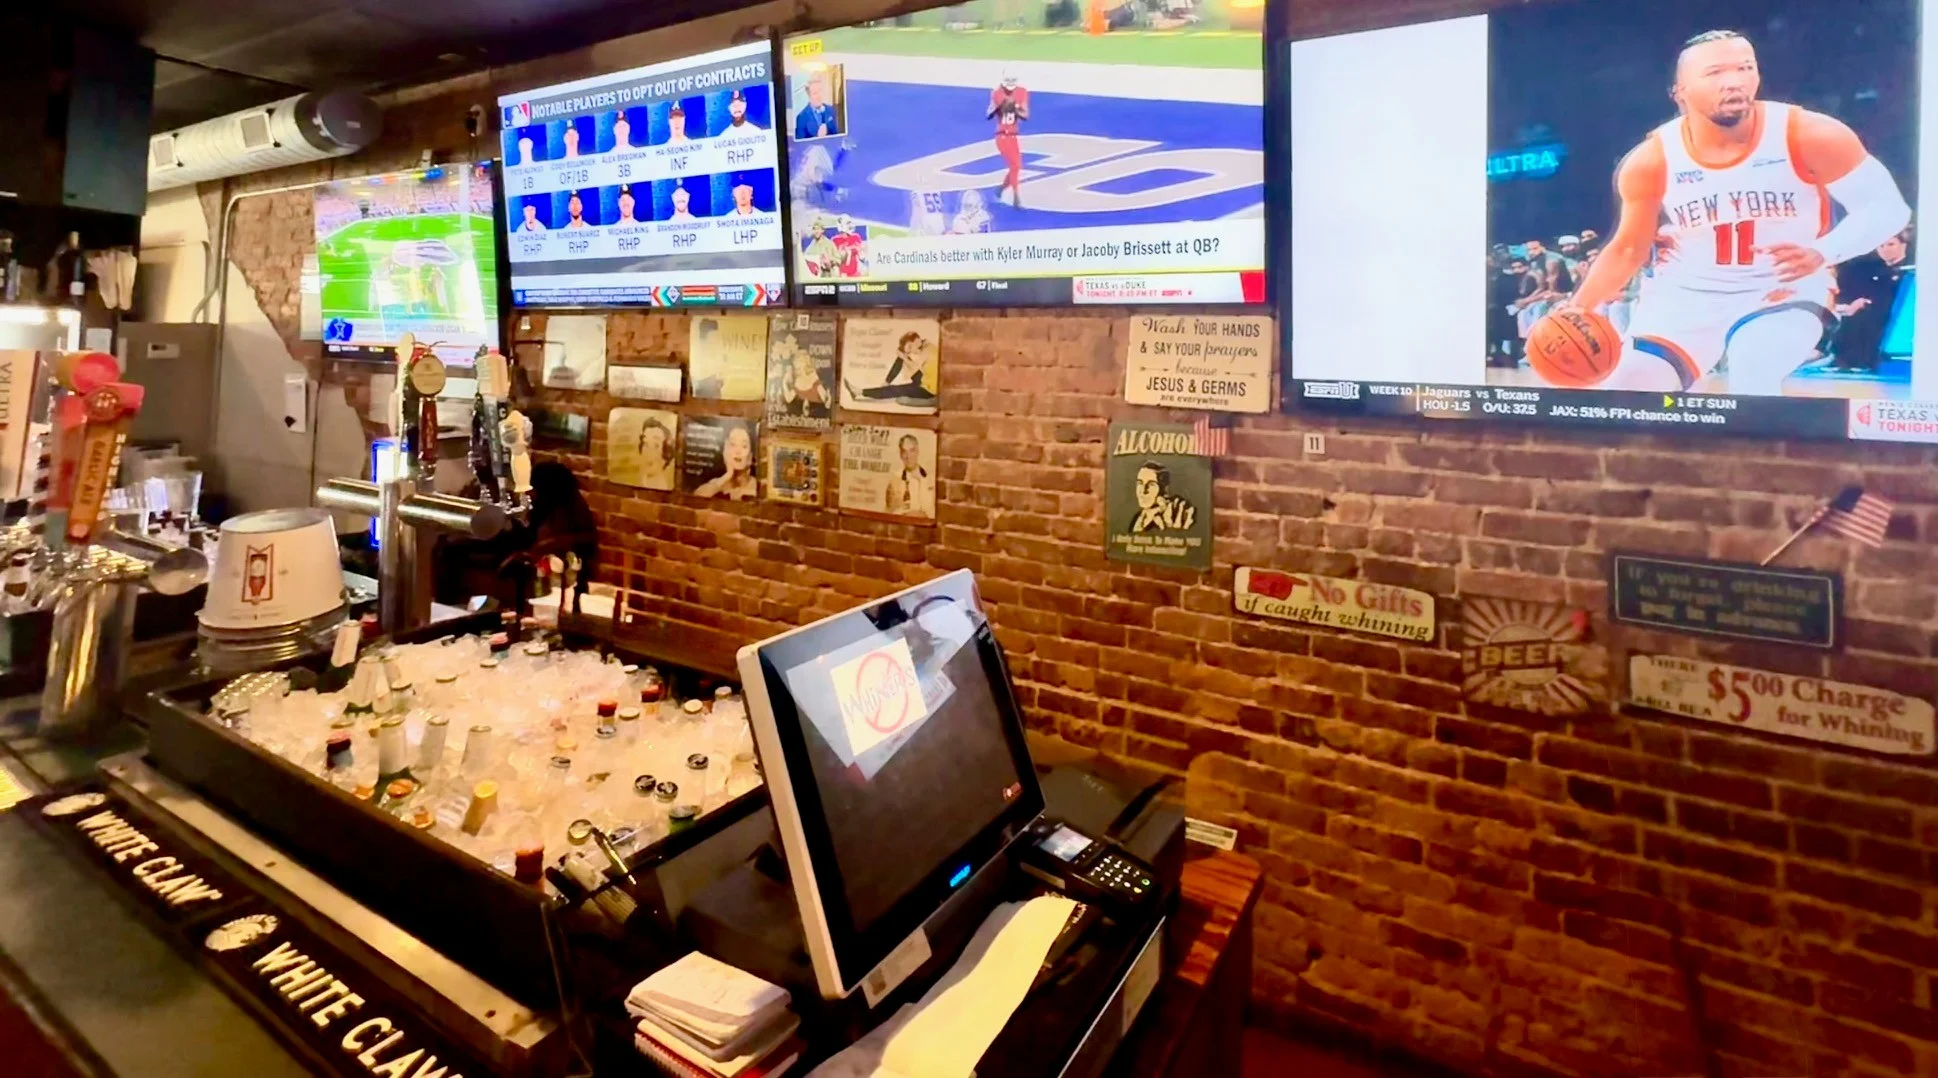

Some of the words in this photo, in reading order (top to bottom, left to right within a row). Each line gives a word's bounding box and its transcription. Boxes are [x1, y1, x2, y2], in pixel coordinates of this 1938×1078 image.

[532, 101, 573, 119] NOTABLE
[573, 90, 616, 112] PLAYERS
[617, 88, 631, 103] TO
[633, 84, 652, 100] OPT
[655, 79, 677, 96] OUT
[678, 76, 692, 92] OF
[695, 62, 765, 89] CONTRACTS
[714, 139, 736, 149] LUCAS
[738, 135, 767, 146] GIOLITO
[670, 157, 688, 171] INF
[728, 148, 754, 165] RHP
[559, 169, 589, 186] OF/1B
[618, 164, 632, 178] 3B
[523, 177, 534, 189] 1B
[1674, 193, 1718, 229] NEW
[1728, 191, 1797, 217] YORK
[716, 219, 739, 228] SHOTA
[741, 217, 774, 227] IMANAGA
[618, 237, 640, 250] RHP
[673, 233, 697, 248] RHP
[733, 229, 758, 244] LHP
[1713, 220, 1755, 265] 11
[523, 243, 542, 256] RHP
[569, 240, 589, 253] RHP
[877, 252, 891, 265] Are
[894, 250, 938, 264] Cardinals
[941, 249, 970, 263] better
[973, 247, 994, 261] with
[997, 246, 1022, 264] Kyler
[1026, 244, 1064, 261] Murray
[1067, 248, 1078, 258] or
[1082, 242, 1120, 259] Jacoby
[1124, 239, 1172, 256] Brissett
[1176, 240, 1189, 254] at
[1193, 238, 1220, 256] QB?
[1086, 282, 1109, 290] TEXAS
[1125, 281, 1147, 290] DUKE
[1142, 316, 1185, 334] Wash
[1194, 320, 1217, 336] YOUR
[1222, 323, 1260, 338] HANDS
[1140, 341, 1147, 354] &
[1154, 341, 1172, 355] SAY
[1175, 342, 1201, 356] YOUR
[1204, 340, 1258, 363] prayers
[1175, 360, 1218, 376] because
[1146, 377, 1184, 393] JESUS
[1188, 379, 1196, 393] &
[1202, 379, 1247, 397] GERMS
[1369, 385, 1399, 395] WEEK
[1400, 386, 1413, 396] 10
[1422, 386, 1471, 401] Jaguars
[1476, 390, 1489, 400] vs
[1494, 388, 1540, 402] Texans
[1160, 394, 1174, 402] are
[1177, 395, 1229, 406] everywhere
[1686, 398, 1704, 409] ET
[1707, 398, 1737, 410] SUN
[1423, 400, 1448, 411] HOU
[1450, 401, 1470, 412] -1.5
[1483, 402, 1511, 414] O/U:
[1513, 404, 1537, 415] 37.5
[1550, 405, 1577, 418] JAX:
[1580, 406, 1607, 419] 51%
[1609, 407, 1631, 420] FPI
[1633, 410, 1681, 423] chance
[1683, 411, 1698, 423] to
[1700, 412, 1725, 424] win
[1878, 409, 1928, 421] TEXAS
[1310, 577, 1346, 606] No
[1355, 583, 1423, 617] Gifts
[1244, 597, 1258, 614] if
[1264, 602, 1330, 623] caught
[1338, 611, 1429, 641] whining
[1481, 643, 1570, 666] BEER
[1791, 678, 1907, 723] Charge
[1777, 705, 1811, 728] for
[1818, 711, 1926, 750] Whining
[76, 810, 159, 863] WHITE
[133, 856, 220, 905] CLAW
[252, 941, 365, 1027] WHITE
